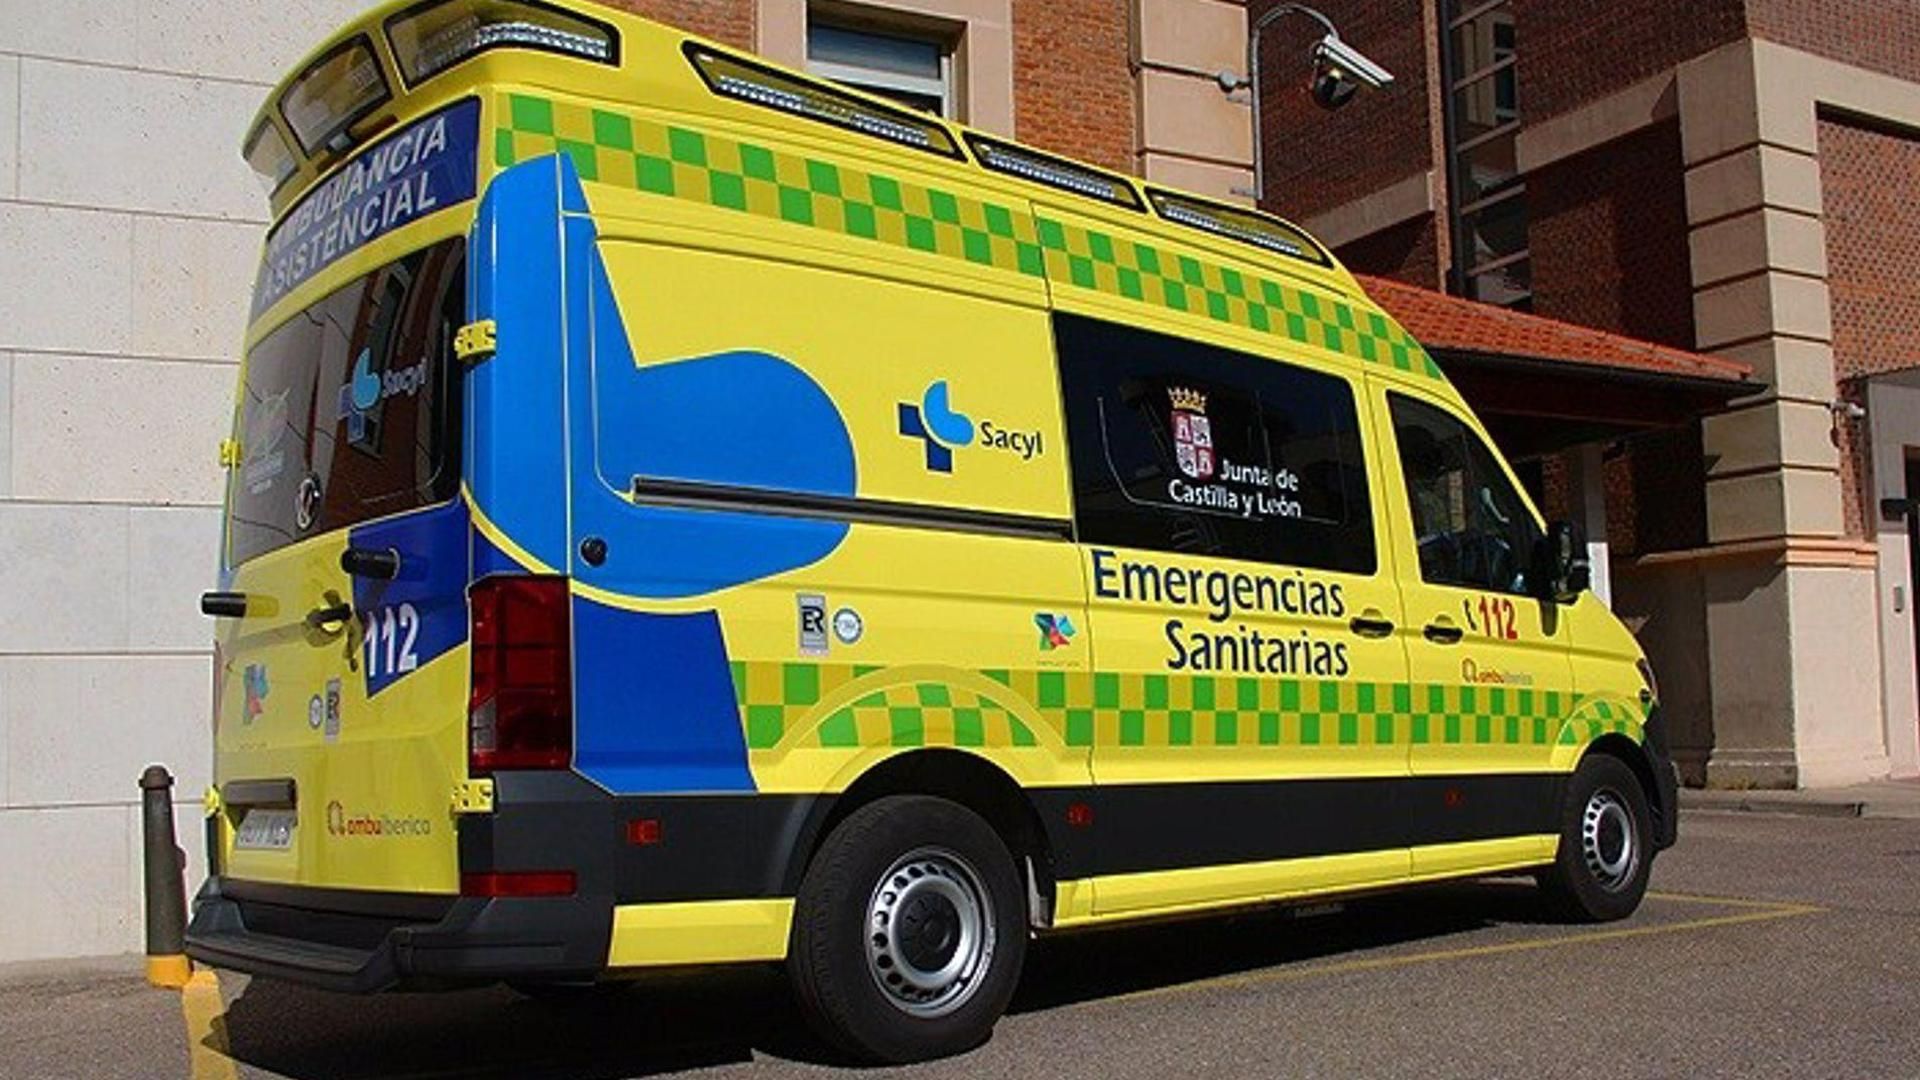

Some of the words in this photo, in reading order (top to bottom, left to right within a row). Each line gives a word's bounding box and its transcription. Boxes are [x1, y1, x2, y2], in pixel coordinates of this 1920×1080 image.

[980, 422, 1044, 460] Sacyl
[1220, 459, 1271, 486] Junta
[1275, 468, 1299, 492] de
[1168, 478, 1238, 509] Castilla
[1242, 493, 1254, 518] y
[1256, 492, 1302, 518] León
[1092, 550, 1345, 620] Emergencias
[801, 605, 824, 633] ER
[1479, 595, 1518, 640] 112
[365, 602, 419, 676] 112
[1166, 621, 1349, 677] Sanitarias
